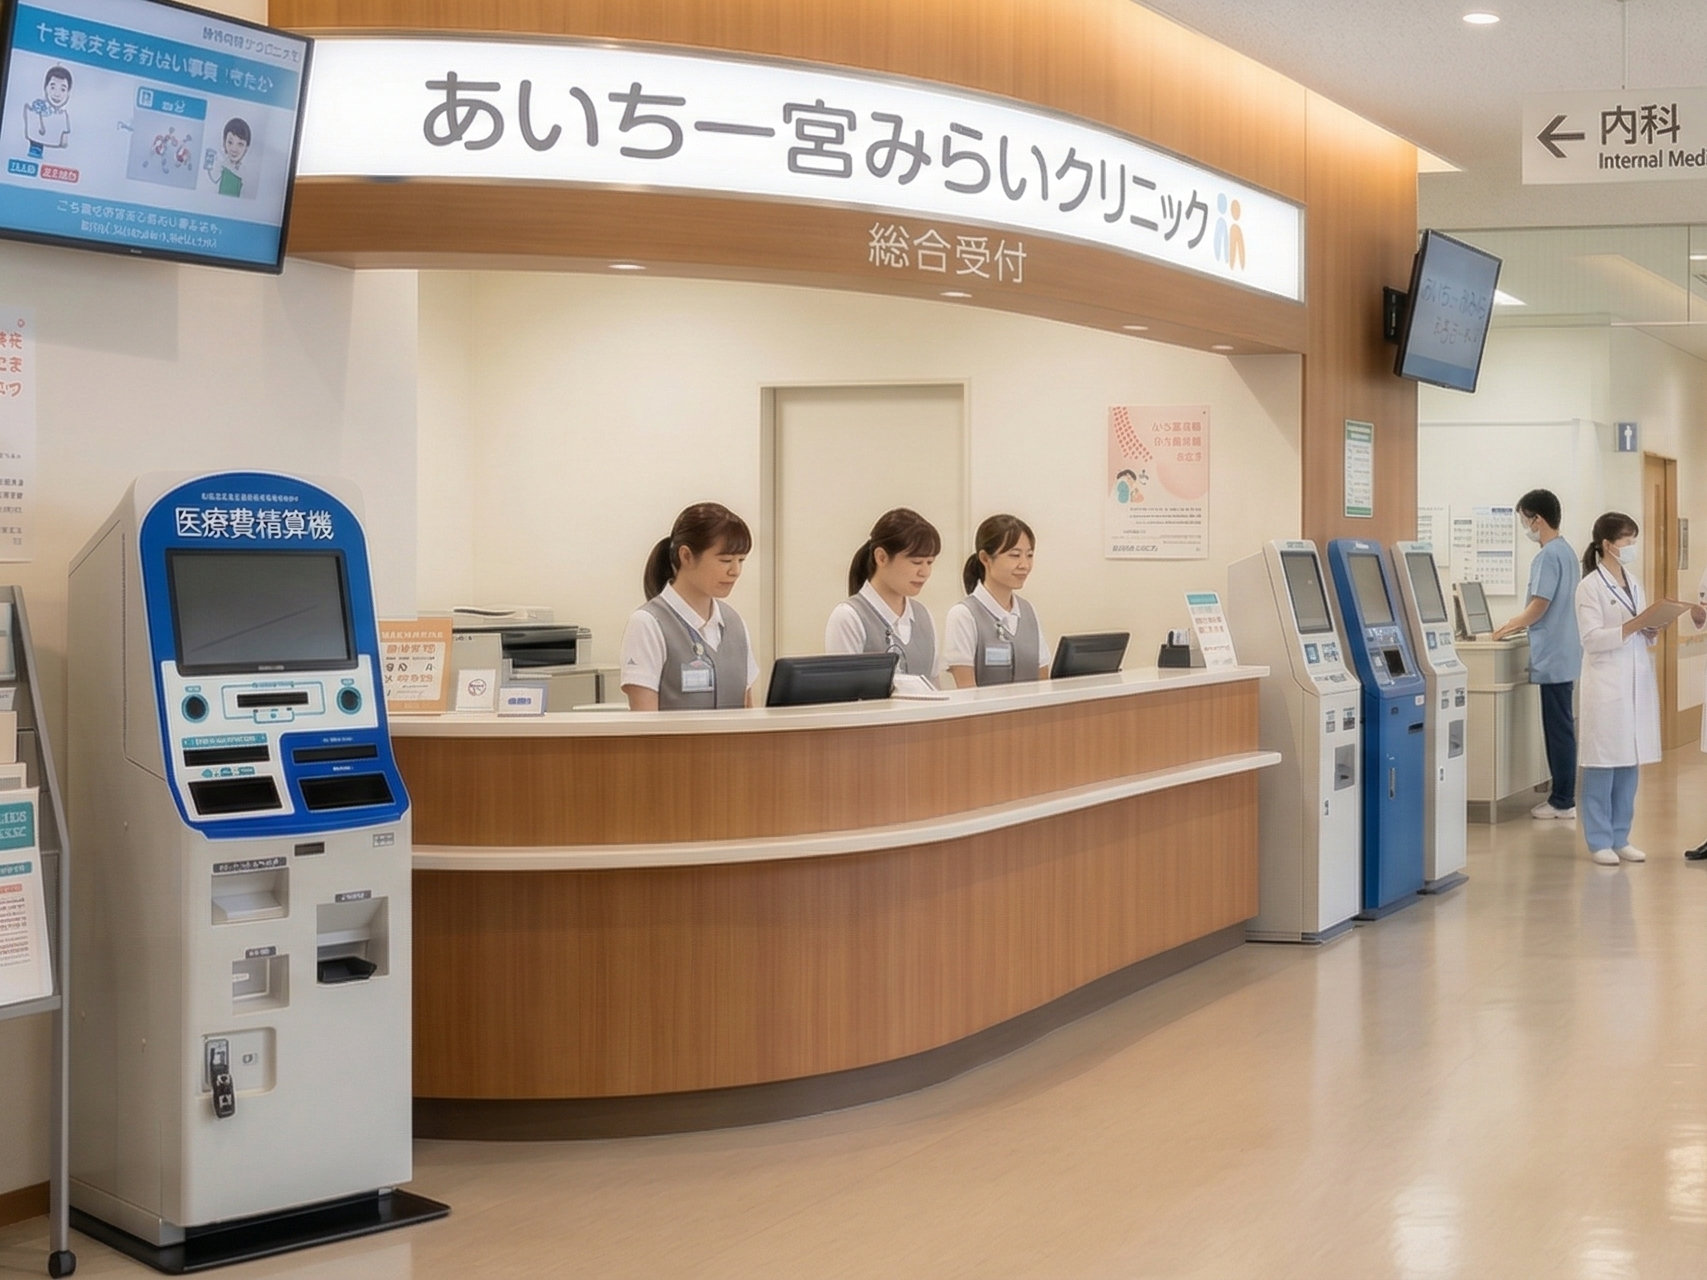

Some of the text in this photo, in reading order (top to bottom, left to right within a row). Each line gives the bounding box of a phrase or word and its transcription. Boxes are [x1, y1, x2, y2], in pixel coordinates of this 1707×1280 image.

[1601, 104, 1681, 146] 内科
[423, 70, 1209, 250] あいち一宮みらいクリニック
[1599, 147, 1707, 169] Internal Med
[868, 222, 1027, 284] 総合受付
[175, 507, 335, 540] 医療費精算機
